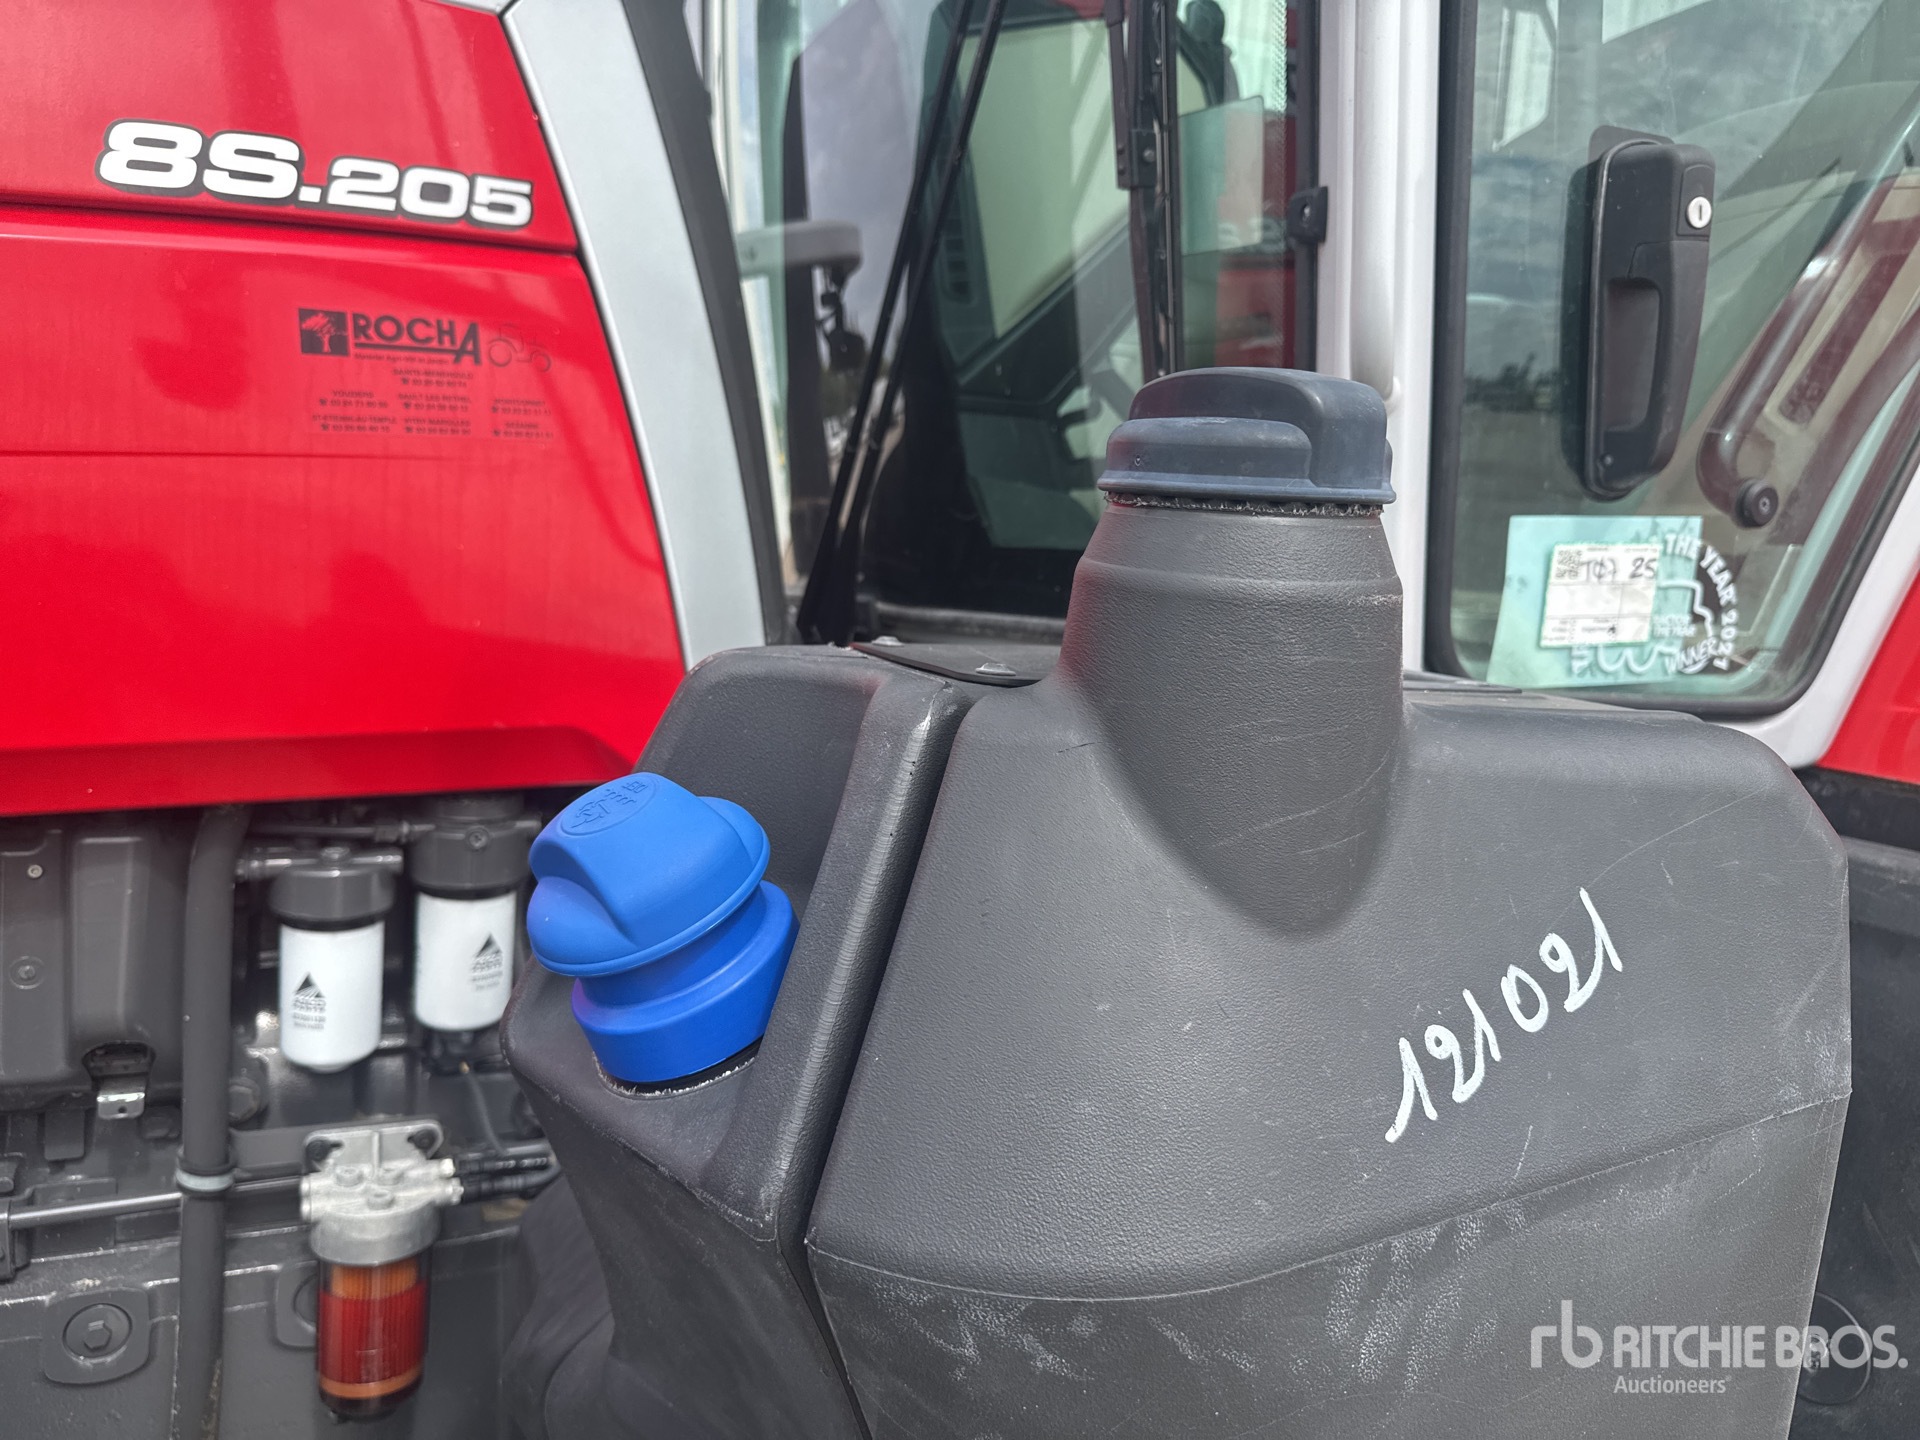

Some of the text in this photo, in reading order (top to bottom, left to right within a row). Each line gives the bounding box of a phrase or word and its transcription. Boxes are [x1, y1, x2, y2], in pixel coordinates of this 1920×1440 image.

[97, 119, 533, 229] 8S.205
[351, 312, 481, 366] ROCHA
[1664, 532, 1738, 671] THE YEAR 2021
[1665, 636, 1719, 673] WINNER
